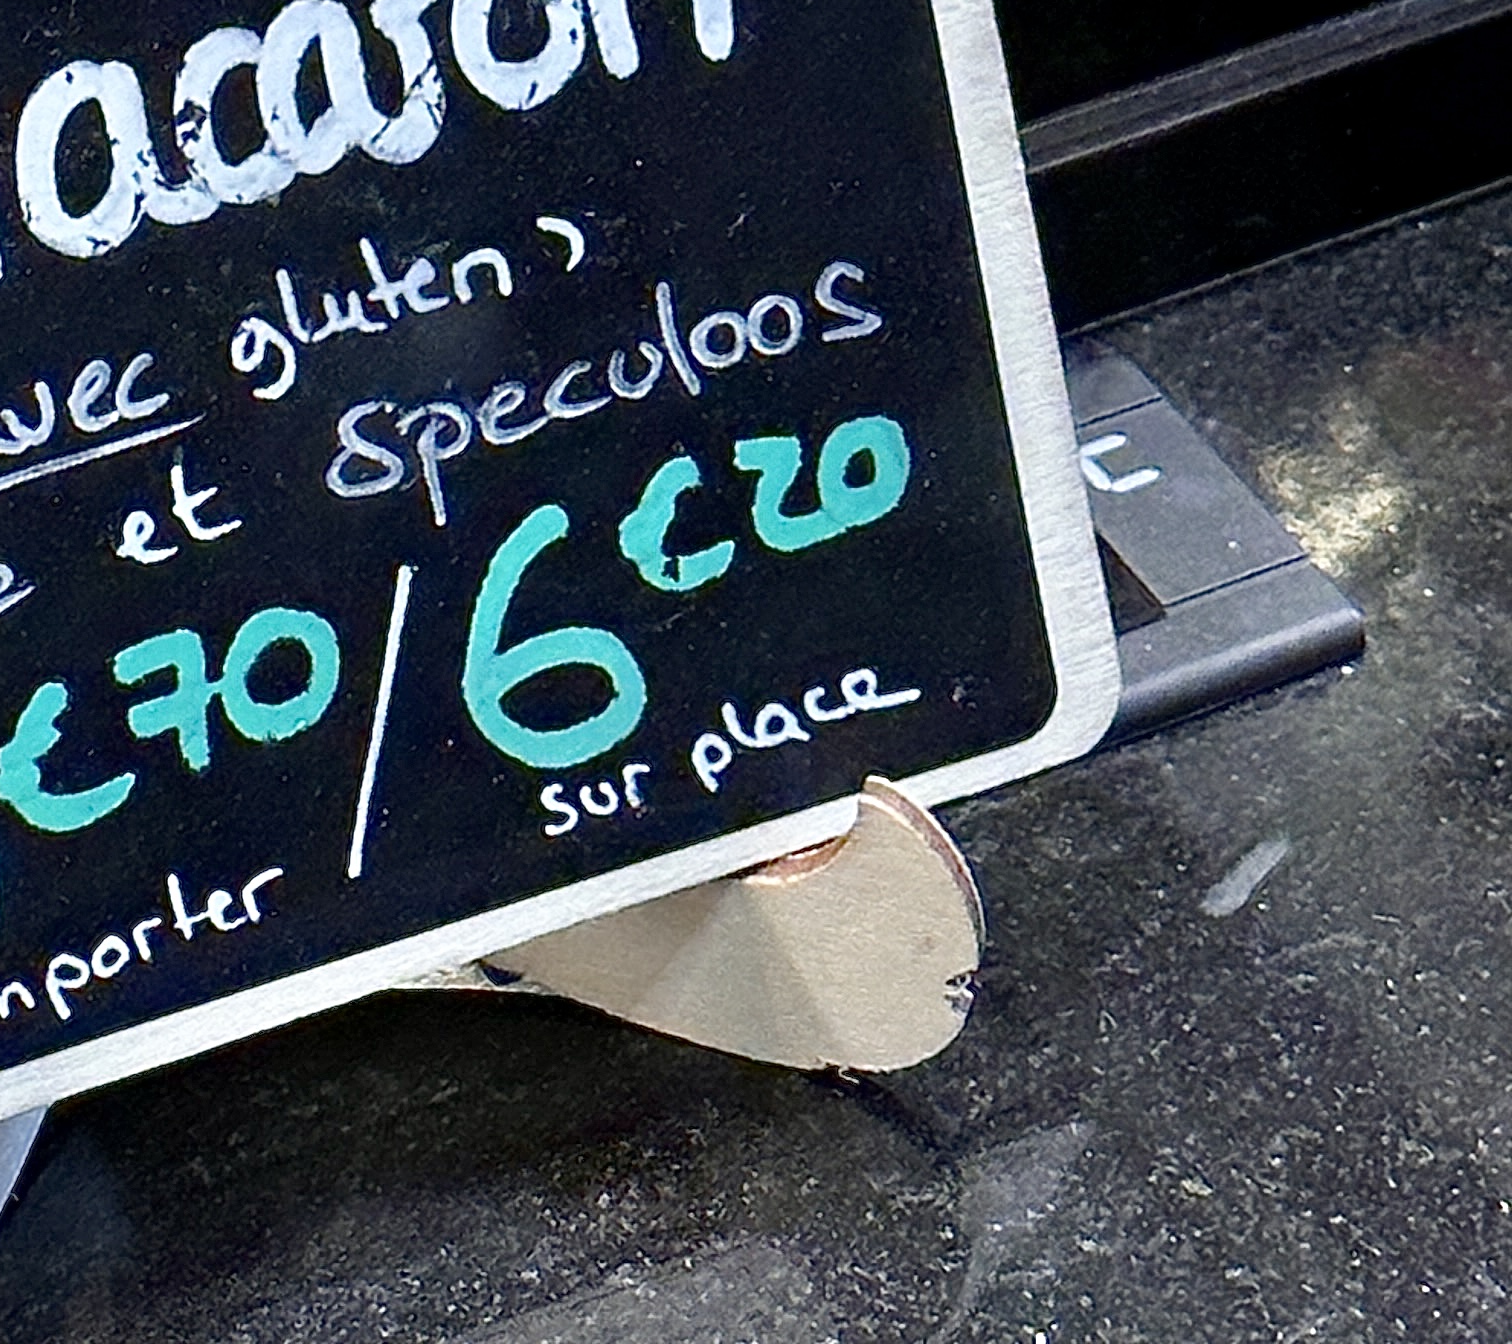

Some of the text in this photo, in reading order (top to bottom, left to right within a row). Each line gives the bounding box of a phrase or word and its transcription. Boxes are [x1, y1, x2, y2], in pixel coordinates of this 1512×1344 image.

[114, 462, 244, 566] et
[538, 667, 923, 838] sur place
